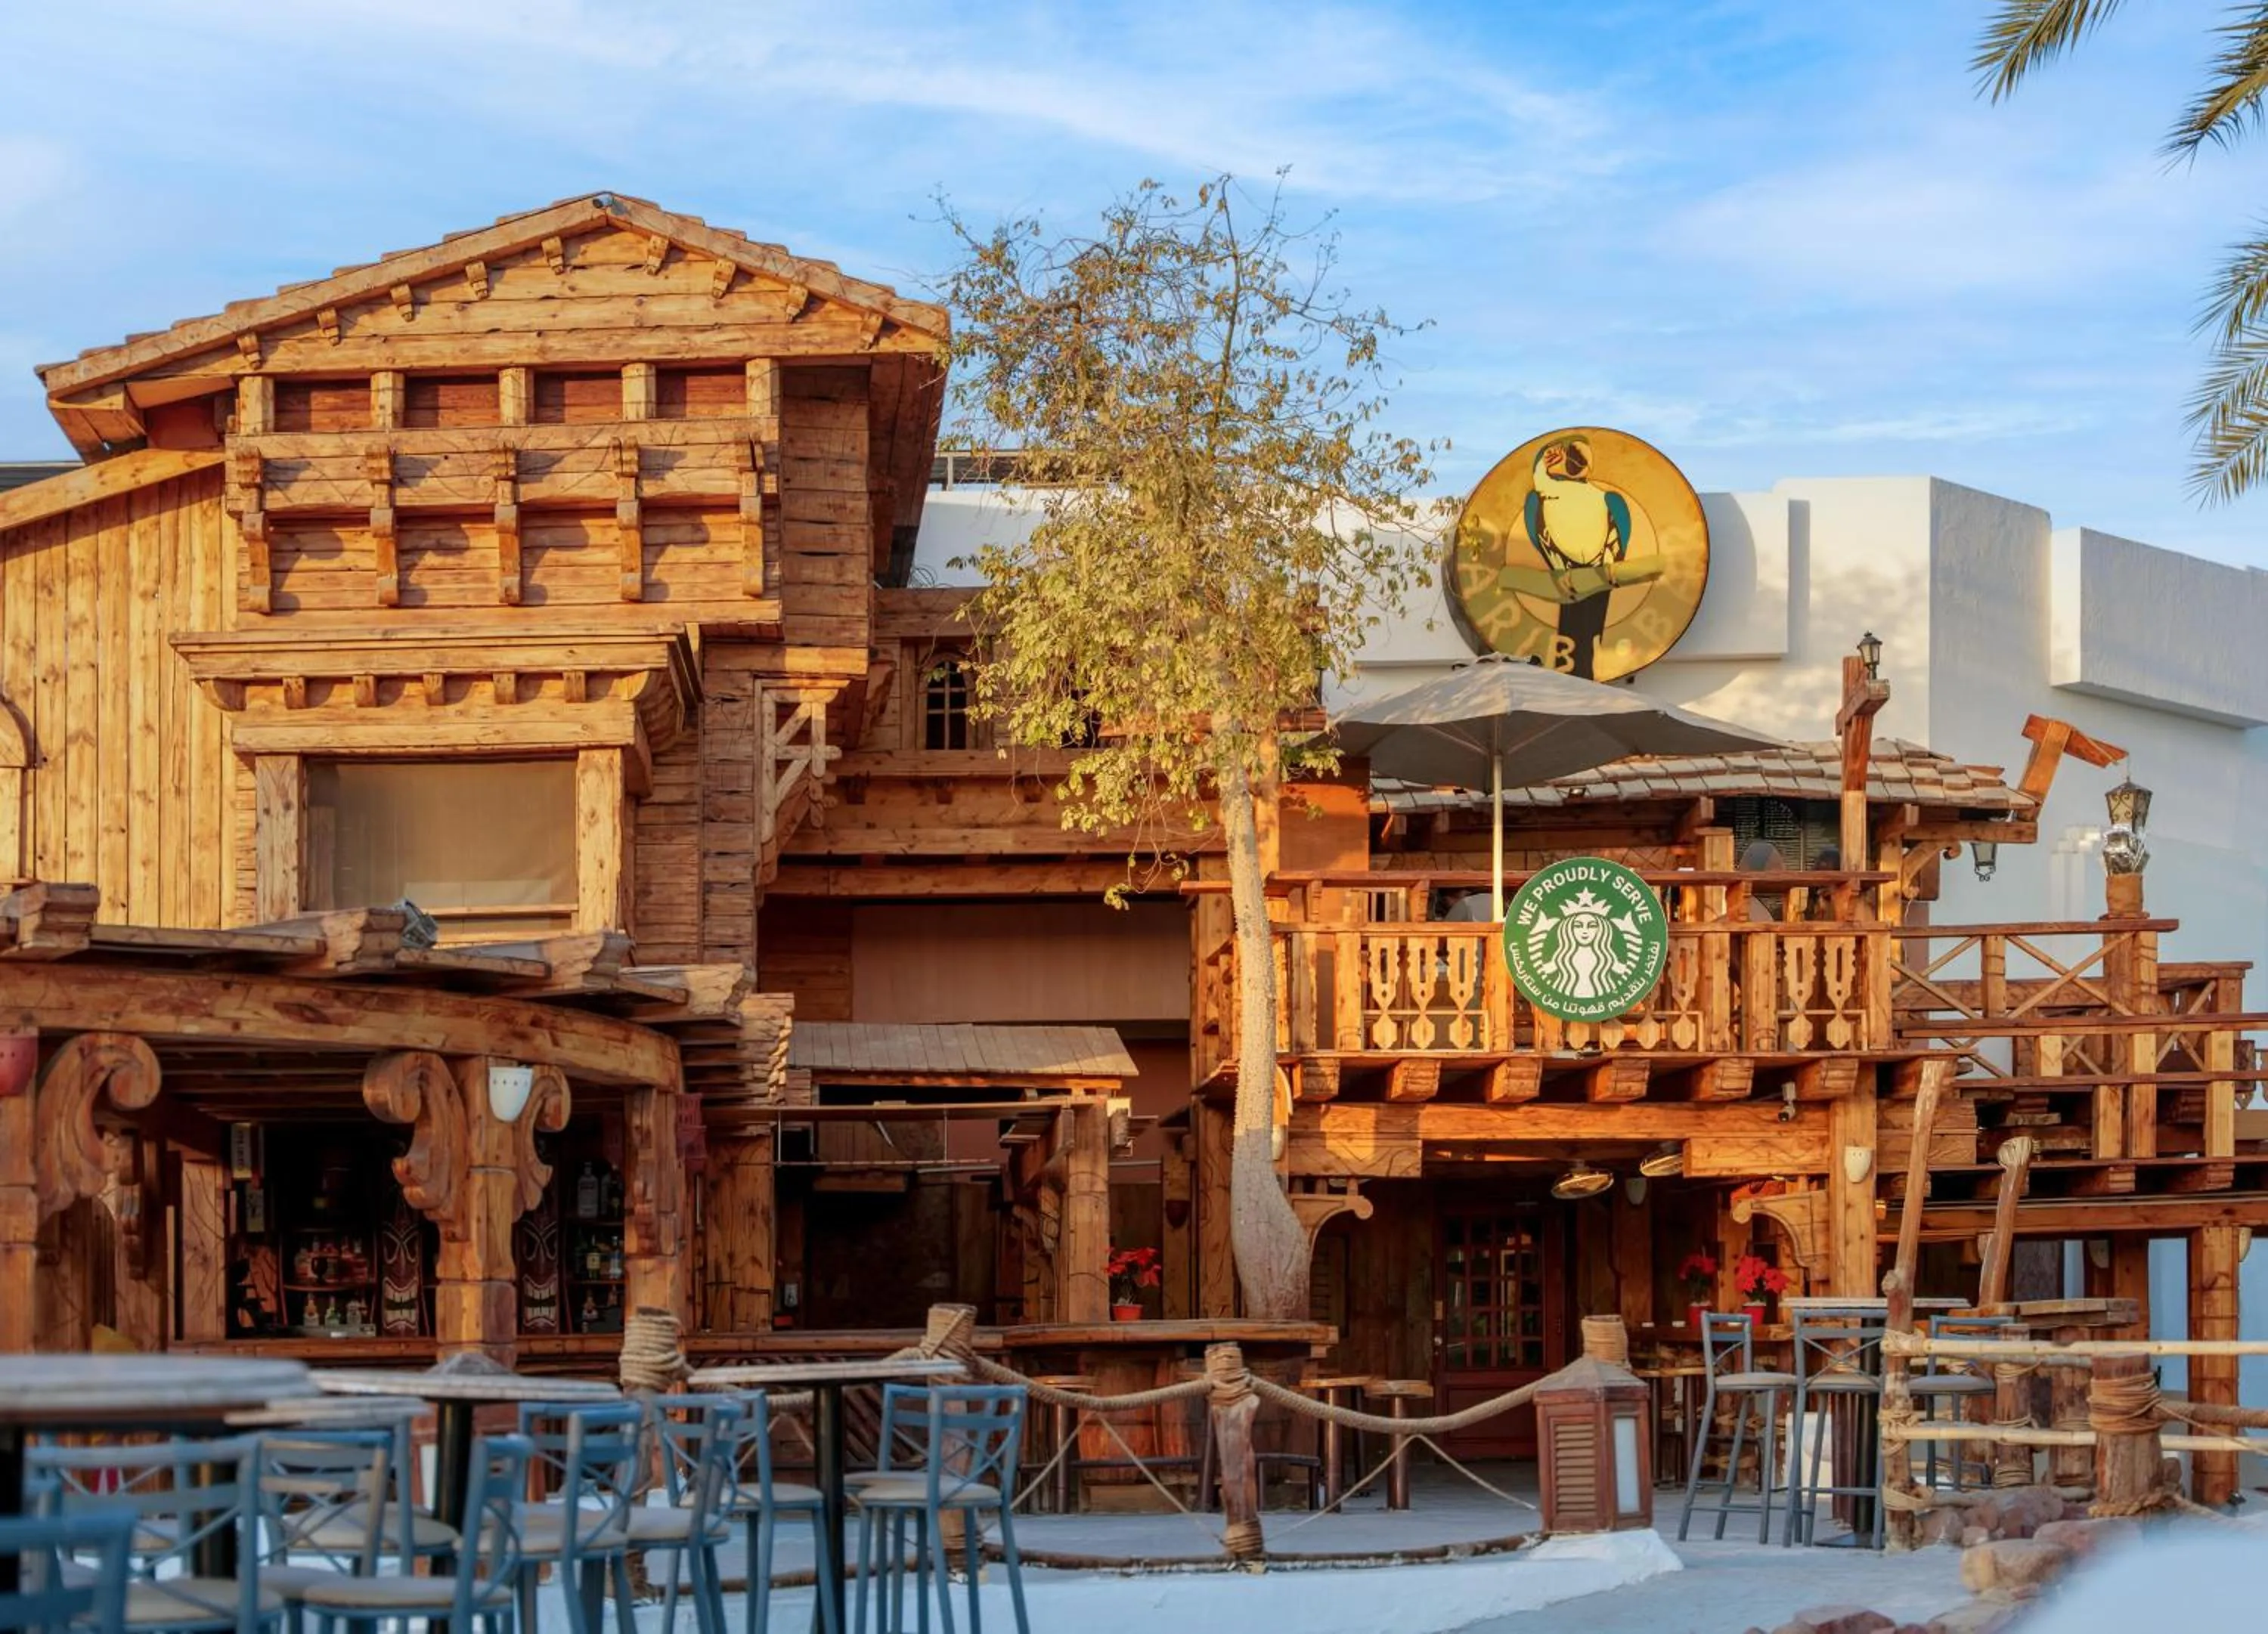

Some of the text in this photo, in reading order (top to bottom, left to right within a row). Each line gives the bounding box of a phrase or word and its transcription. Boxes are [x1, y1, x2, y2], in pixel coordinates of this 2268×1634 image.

[1517, 867, 1653, 926] WE PROUDLY SERVE
[1509, 942, 1542, 995] ستاربكس
[1541, 993, 1560, 1010] من
[1563, 1001, 1605, 1016] قهوتنا
[1607, 979, 1649, 1011] بتقديم
